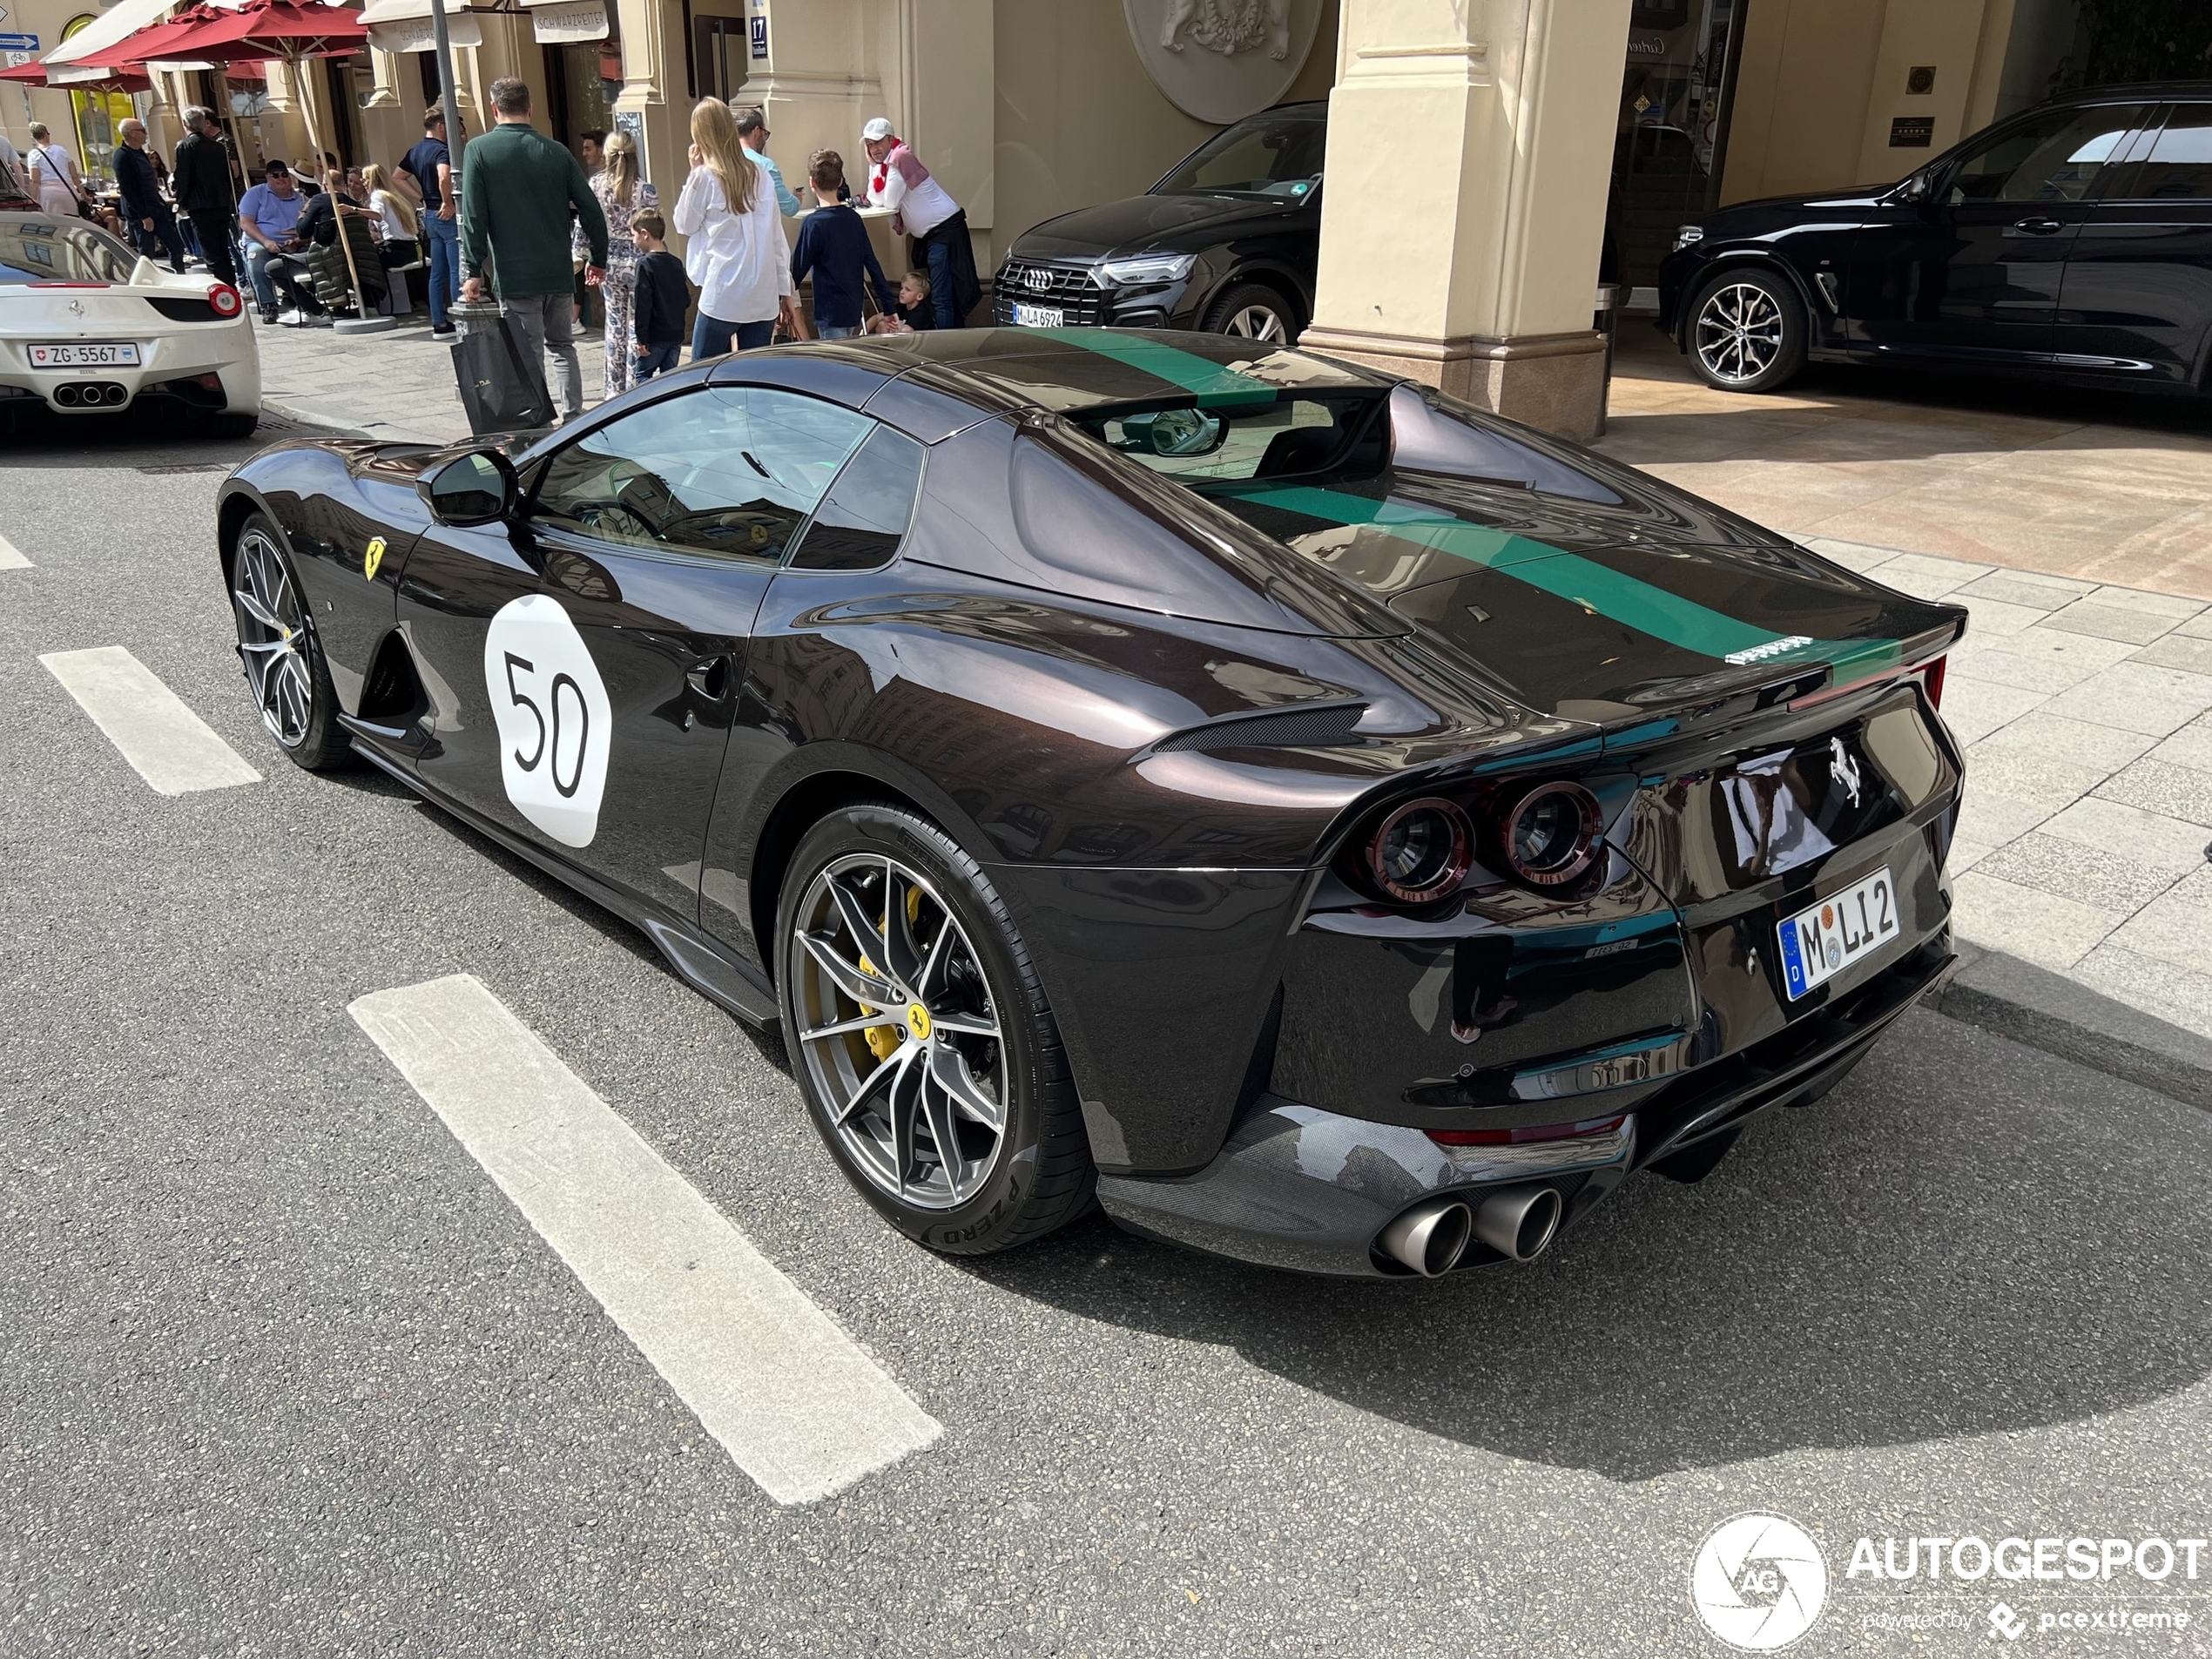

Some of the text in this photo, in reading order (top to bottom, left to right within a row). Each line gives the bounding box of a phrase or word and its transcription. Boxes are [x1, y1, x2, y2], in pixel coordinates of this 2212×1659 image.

[538, 11, 604, 30] SCHWARZREITER
[752, 19, 764, 39] 17
[1017, 307, 1062, 327] M LA 6924
[503, 650, 589, 799] 50
[1801, 915, 1826, 977] M
[1791, 965, 1800, 982] D
[943, 1174, 1021, 1244] P ZERO
